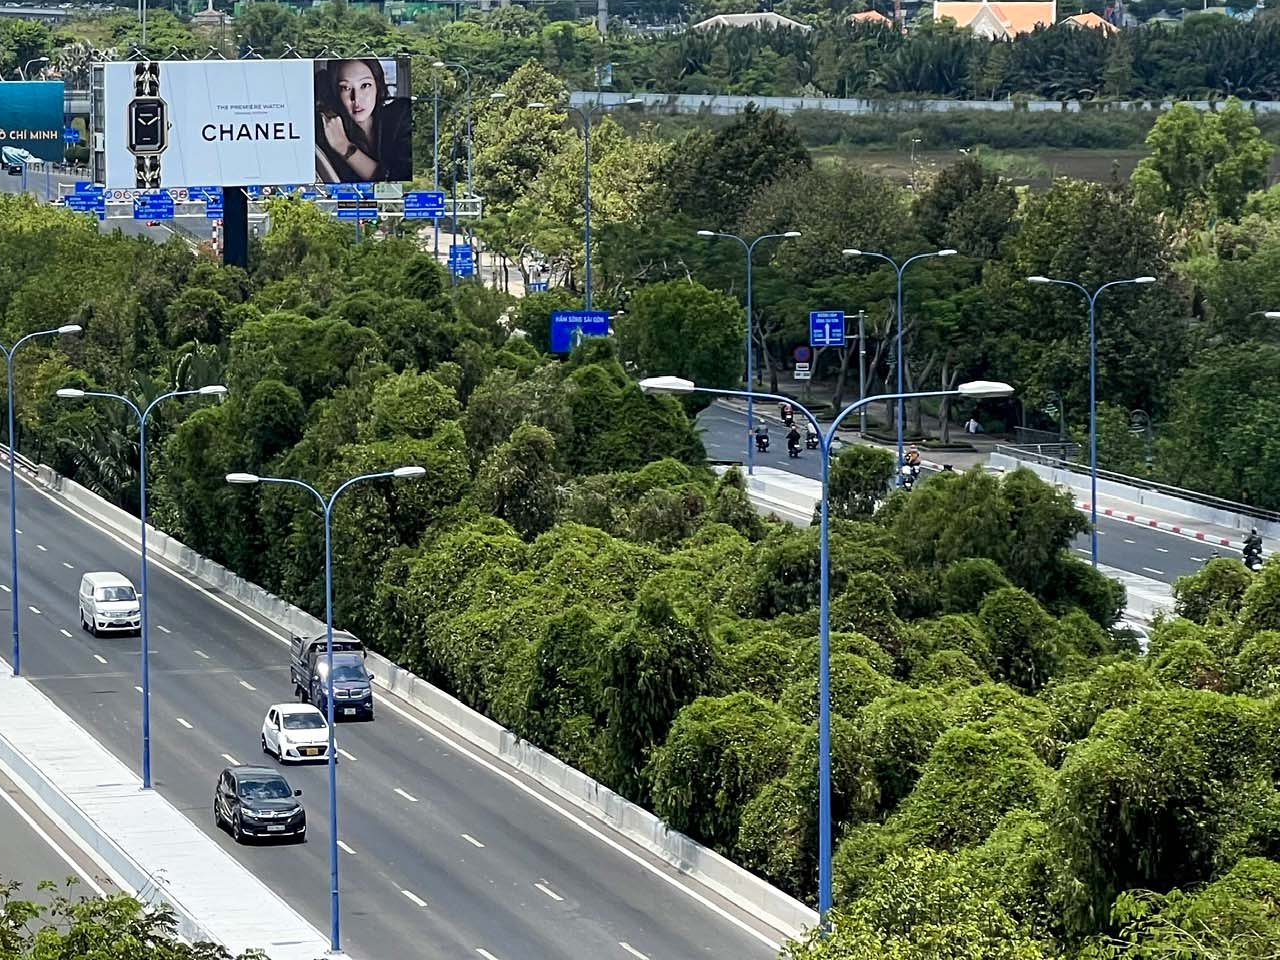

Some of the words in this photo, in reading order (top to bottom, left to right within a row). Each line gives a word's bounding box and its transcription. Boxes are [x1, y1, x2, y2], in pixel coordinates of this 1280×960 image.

[9, 129, 27, 140] CHÍ
[30, 130, 58, 140] MINH
[202, 123, 300, 141] CHANEL
